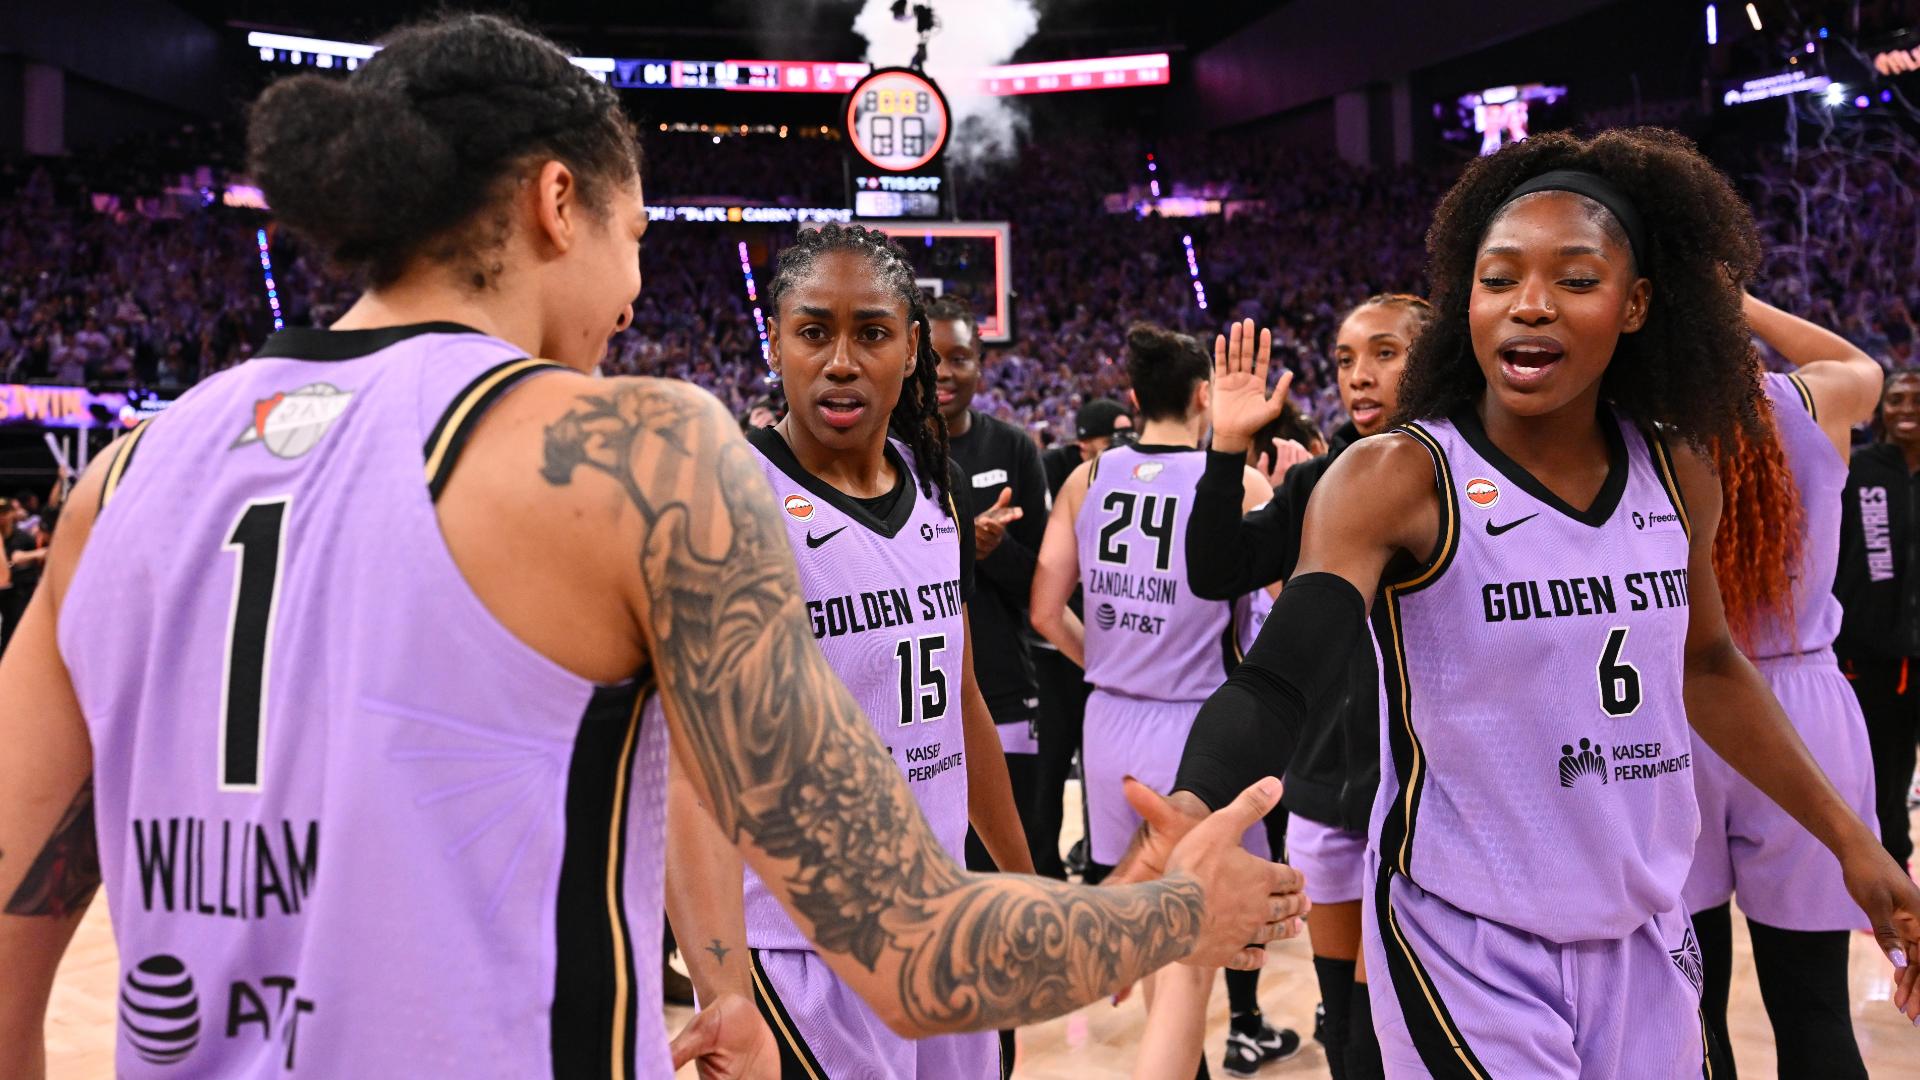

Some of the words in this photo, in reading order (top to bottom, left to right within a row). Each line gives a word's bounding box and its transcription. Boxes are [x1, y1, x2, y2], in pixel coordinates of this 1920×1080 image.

[879, 176, 941, 191] TISSOT
[1097, 490, 1180, 574] 24
[1649, 512, 1680, 528] freedo
[1859, 486, 1894, 582] VALKYRIES
[805, 587, 914, 639] GOLDEN
[917, 578, 962, 621] STAT
[1089, 568, 1178, 606] ZANDALASINI
[1482, 575, 1617, 622] GOLDEN
[1624, 568, 1688, 611] STAT
[218, 495, 295, 794] 1
[1120, 612, 1166, 635] AT&T
[893, 632, 949, 728] 15
[1596, 626, 1643, 718] 6
[1612, 742, 1662, 761] KAISER
[1614, 753, 1690, 781] PERMANENTE
[225, 975, 316, 1071] ATT
